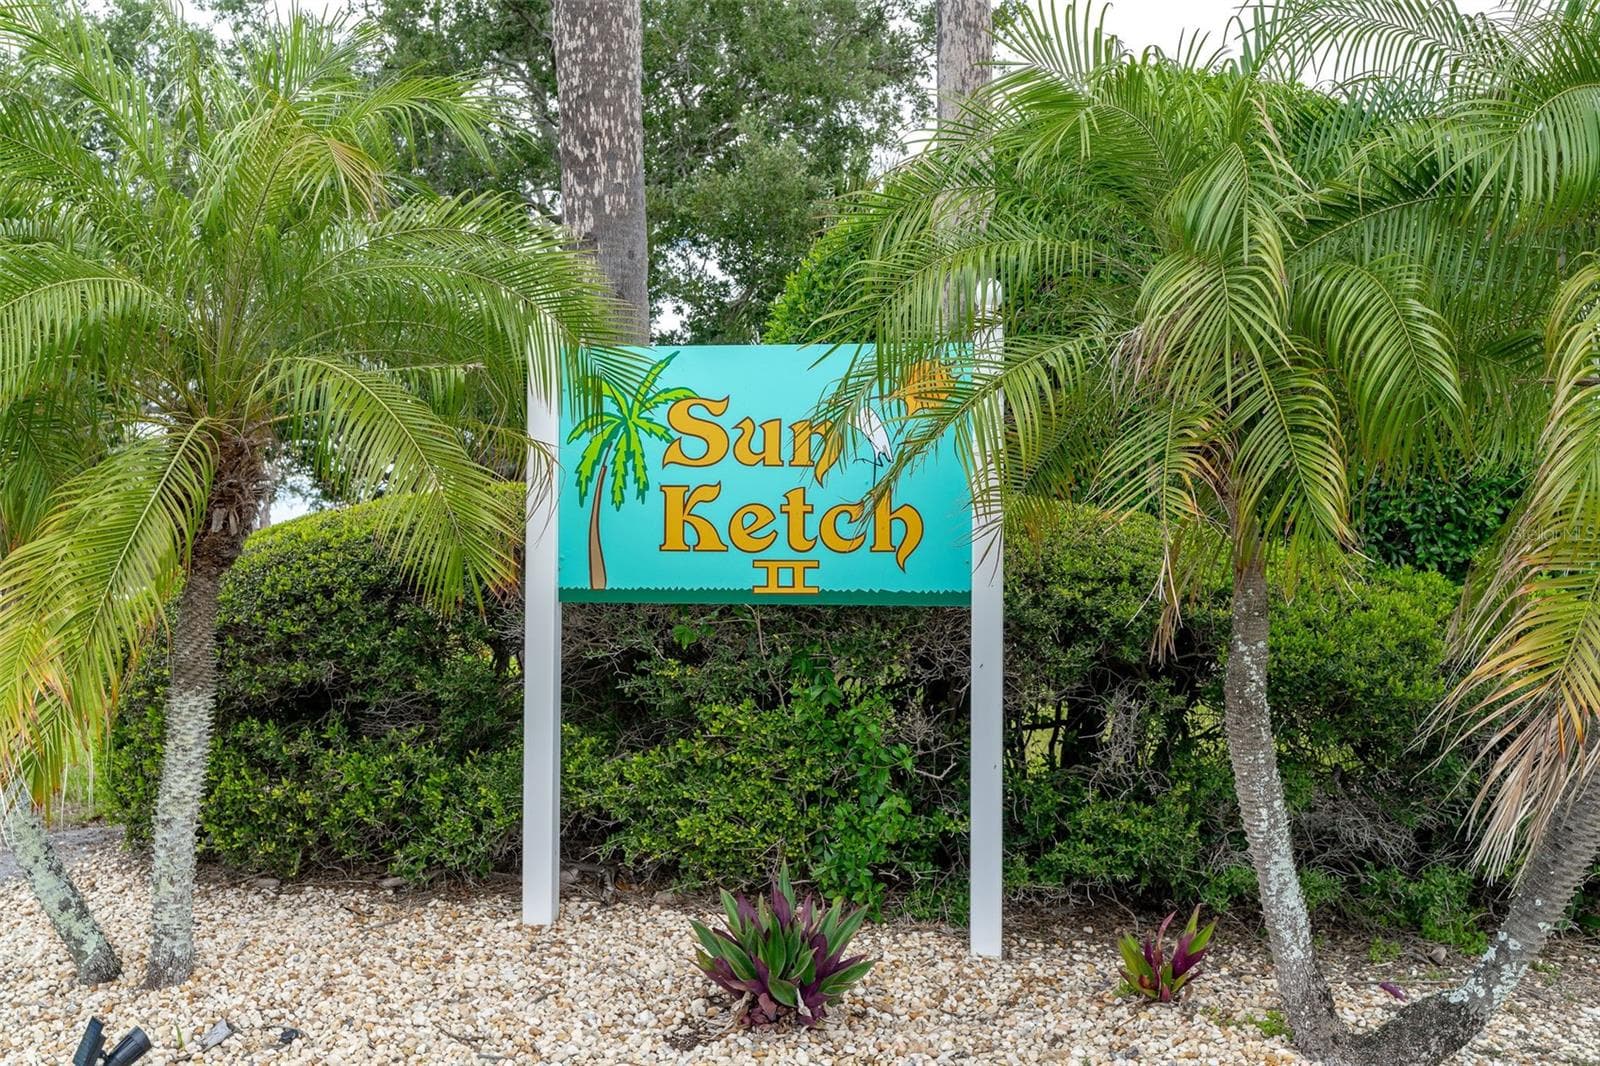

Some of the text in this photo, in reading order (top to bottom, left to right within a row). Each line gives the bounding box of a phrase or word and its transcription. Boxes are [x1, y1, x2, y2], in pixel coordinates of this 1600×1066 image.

[663, 395, 844, 488] Sun
[659, 480, 925, 574] Ketch
[752, 559, 820, 594] II
